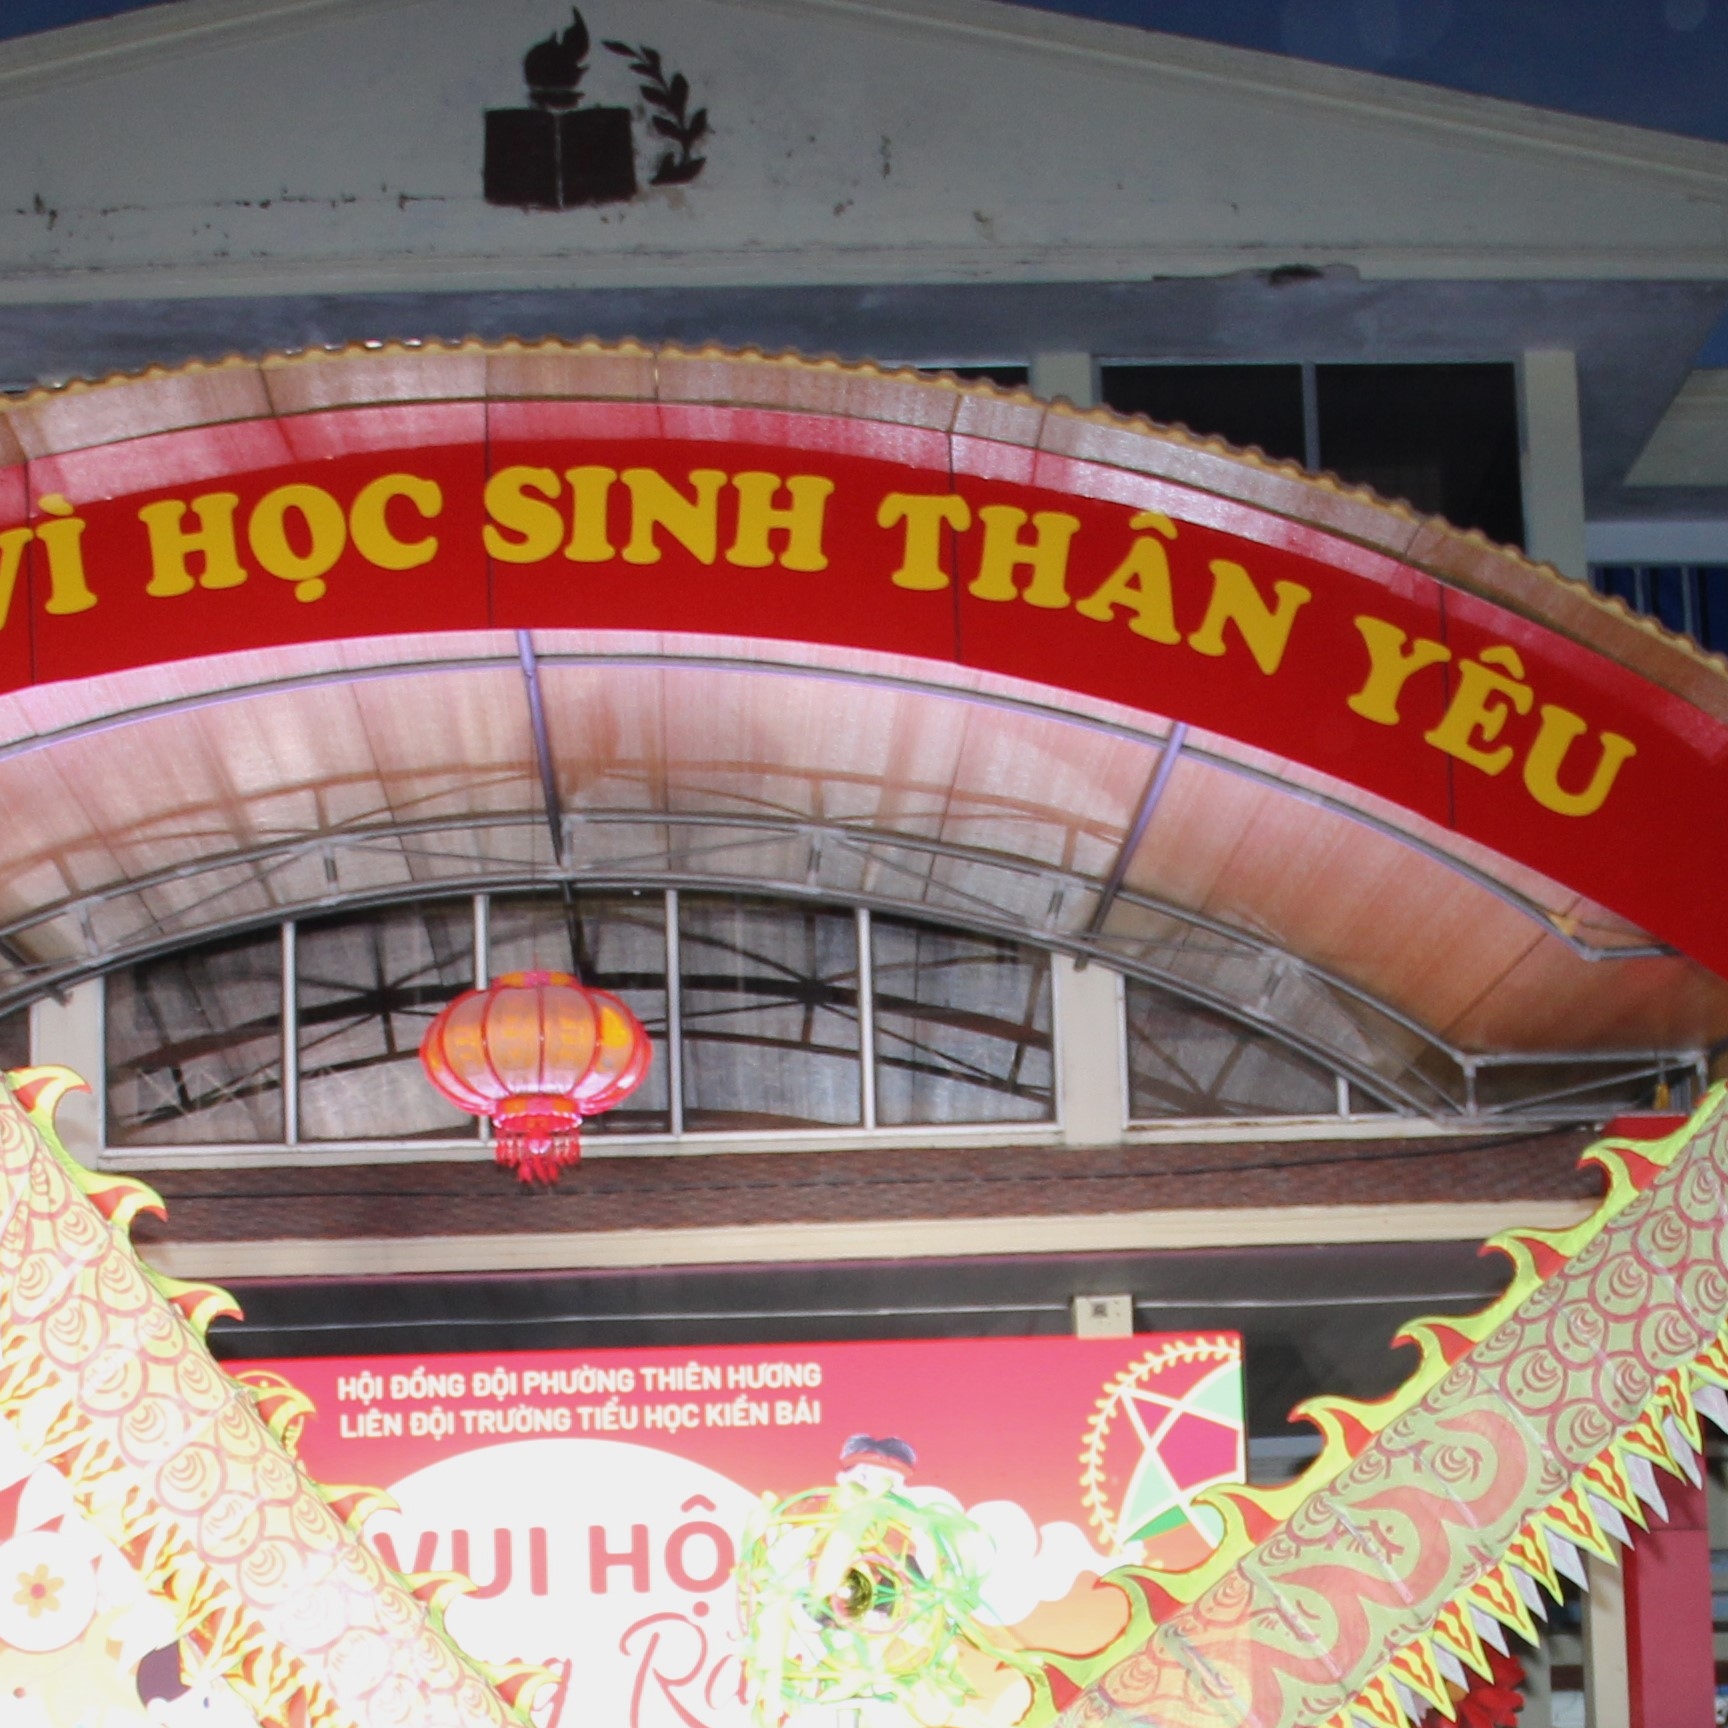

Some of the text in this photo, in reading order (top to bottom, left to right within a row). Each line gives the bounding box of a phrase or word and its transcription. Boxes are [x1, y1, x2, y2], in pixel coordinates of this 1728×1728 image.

[138, 474, 442, 602] HỌC
[482, 466, 834, 571] SINH
[876, 492, 1311, 675] THÂN
[1347, 615, 1636, 816] YÊU
[337, 1361, 822, 1406] HỘI ĐỒNG ĐỘI PHƯỜNG THIÊN HƯƠNG
[340, 1408, 403, 1438] LIÊN
[410, 1405, 455, 1441] ĐỘI
[460, 1404, 571, 1434] TRƯỜNG
[576, 1396, 638, 1431] TIỂU
[644, 1403, 700, 1434] HỌC
[775, 1395, 820, 1425] BÁI
[588, 1493, 735, 1618] HỘ
